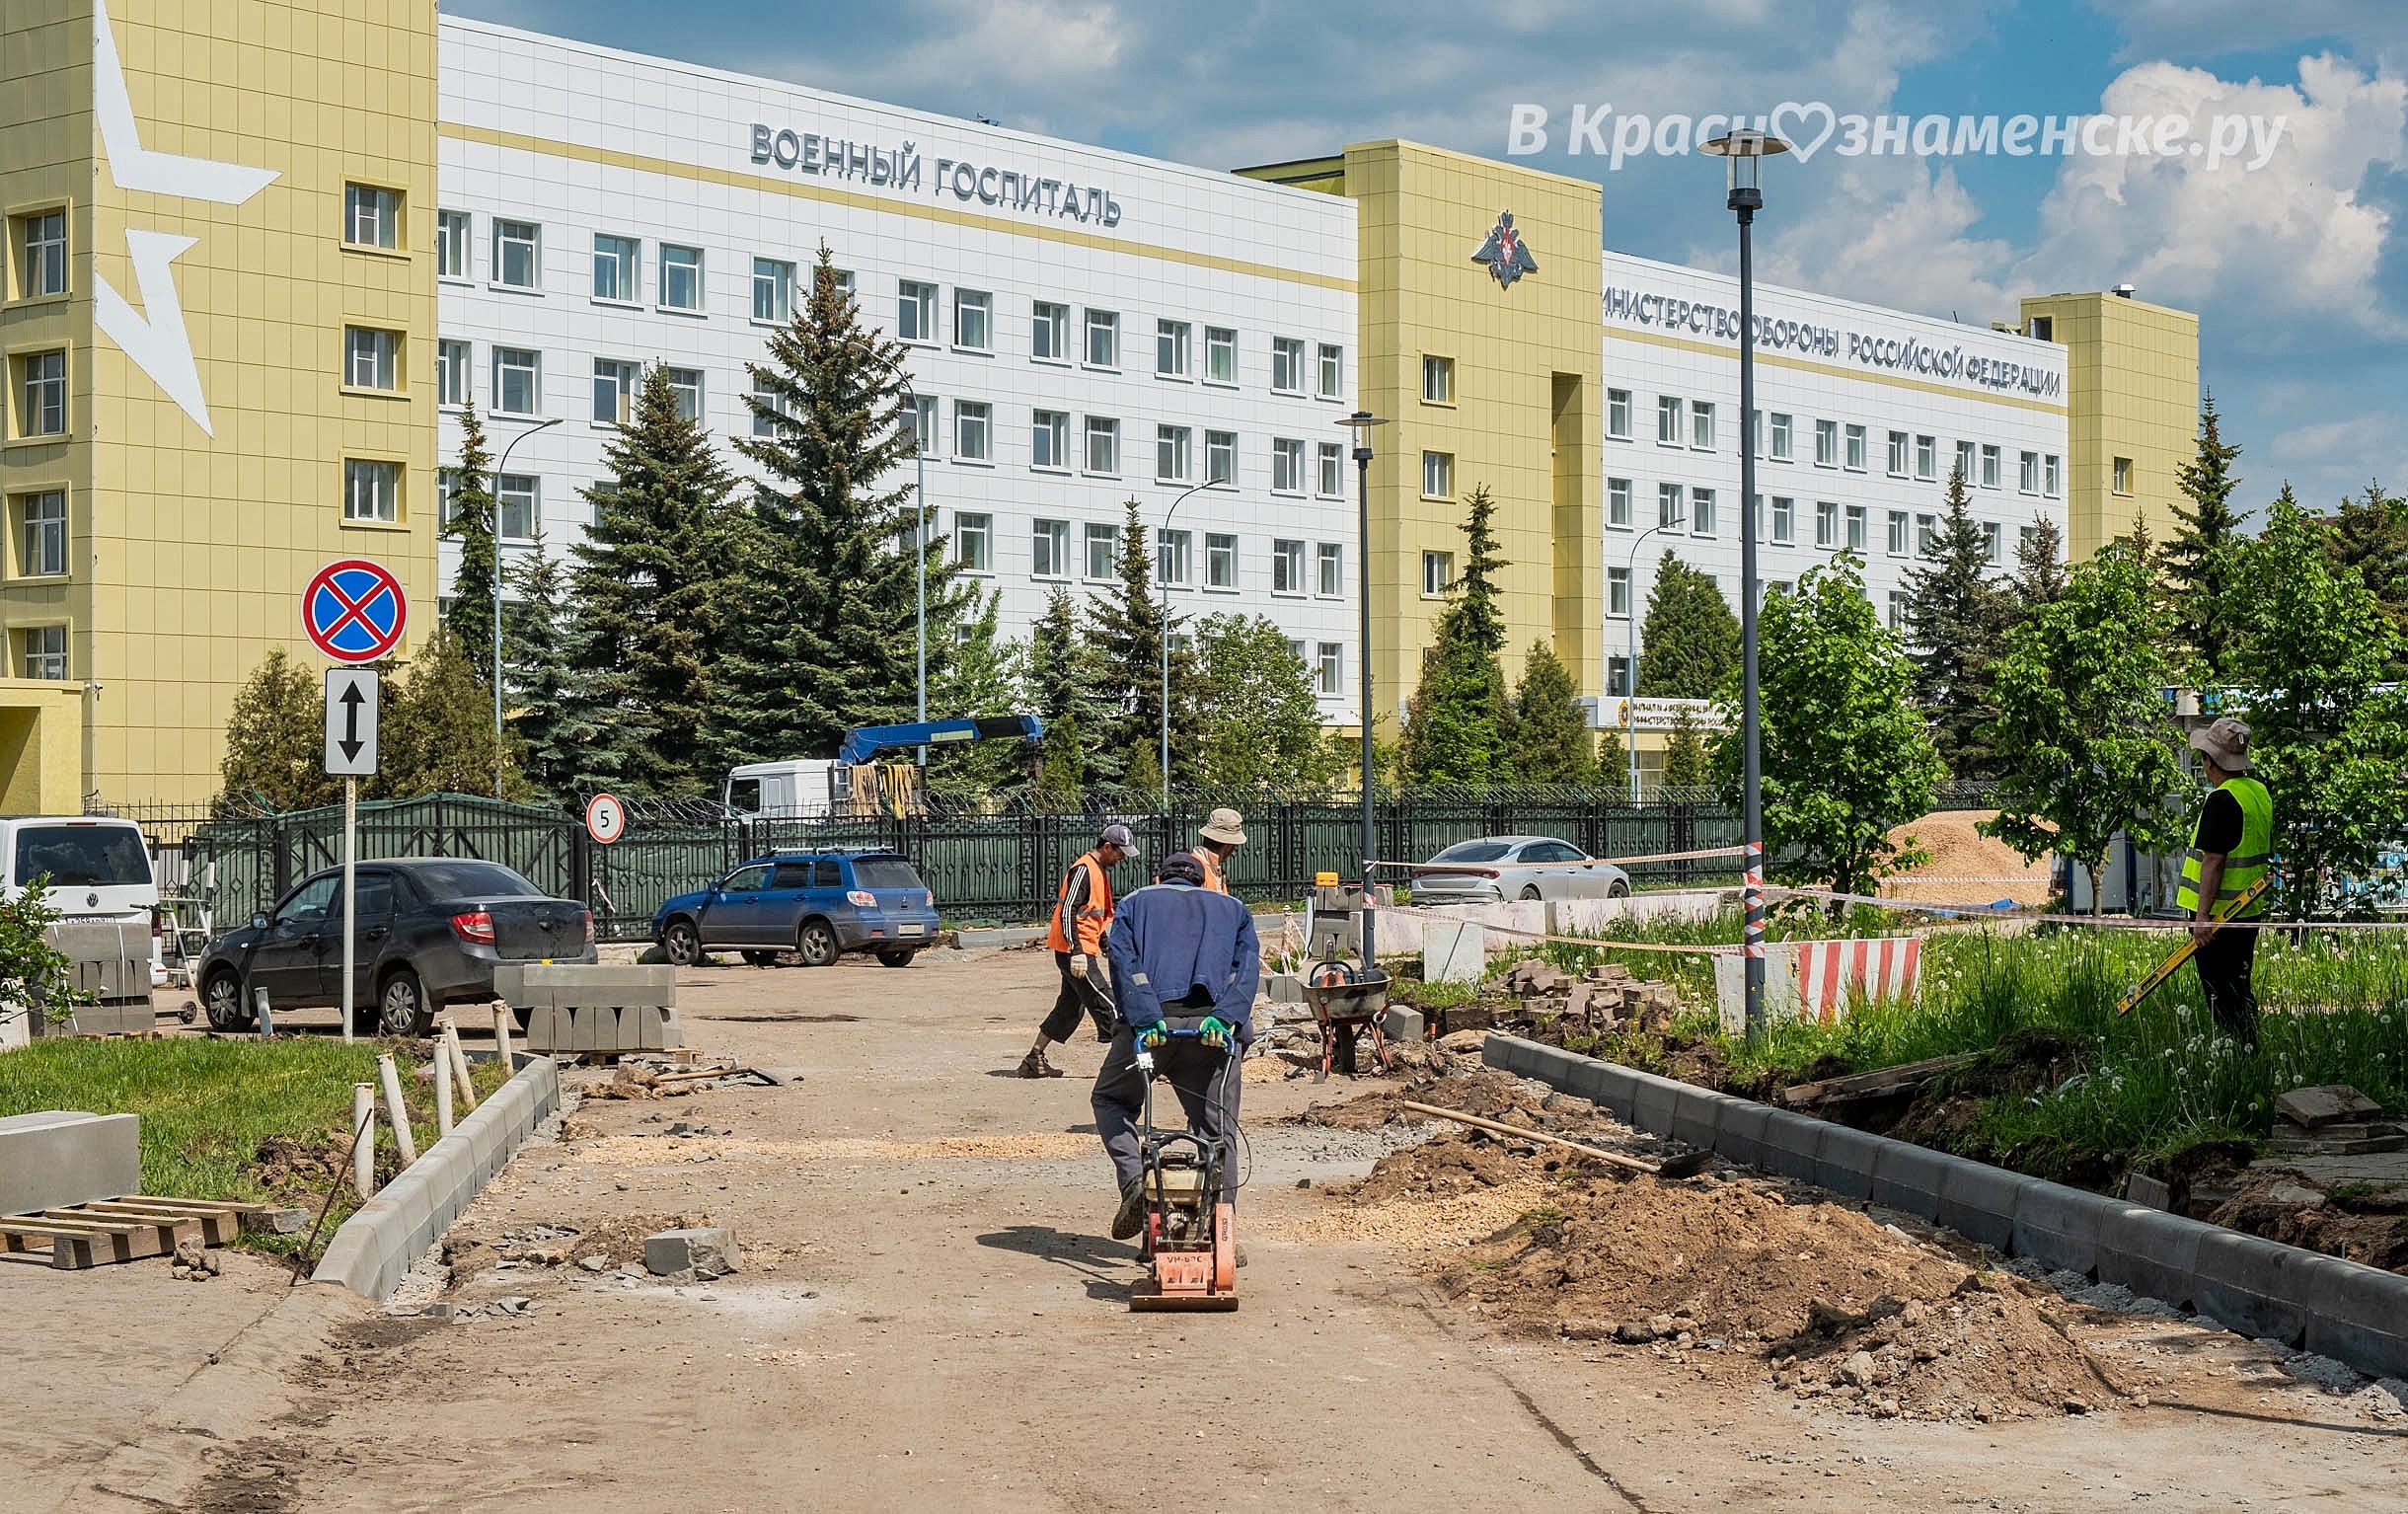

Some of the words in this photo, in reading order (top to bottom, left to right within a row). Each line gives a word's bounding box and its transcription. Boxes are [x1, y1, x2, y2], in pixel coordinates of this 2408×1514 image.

[750, 122, 921, 192] ВОЕННЫЙ
[935, 158, 1122, 227] ГОСПИТАЛЬ
[1602, 285, 1741, 340] ИНИСТЕРСТВО
[1752, 314, 1839, 357] ОБОРОНЫ
[1847, 332, 1964, 380] РОССИЙСКОЙ
[1965, 355, 2061, 398] ФЕДЕРАЦИИ
[600, 809, 610, 828] 5
